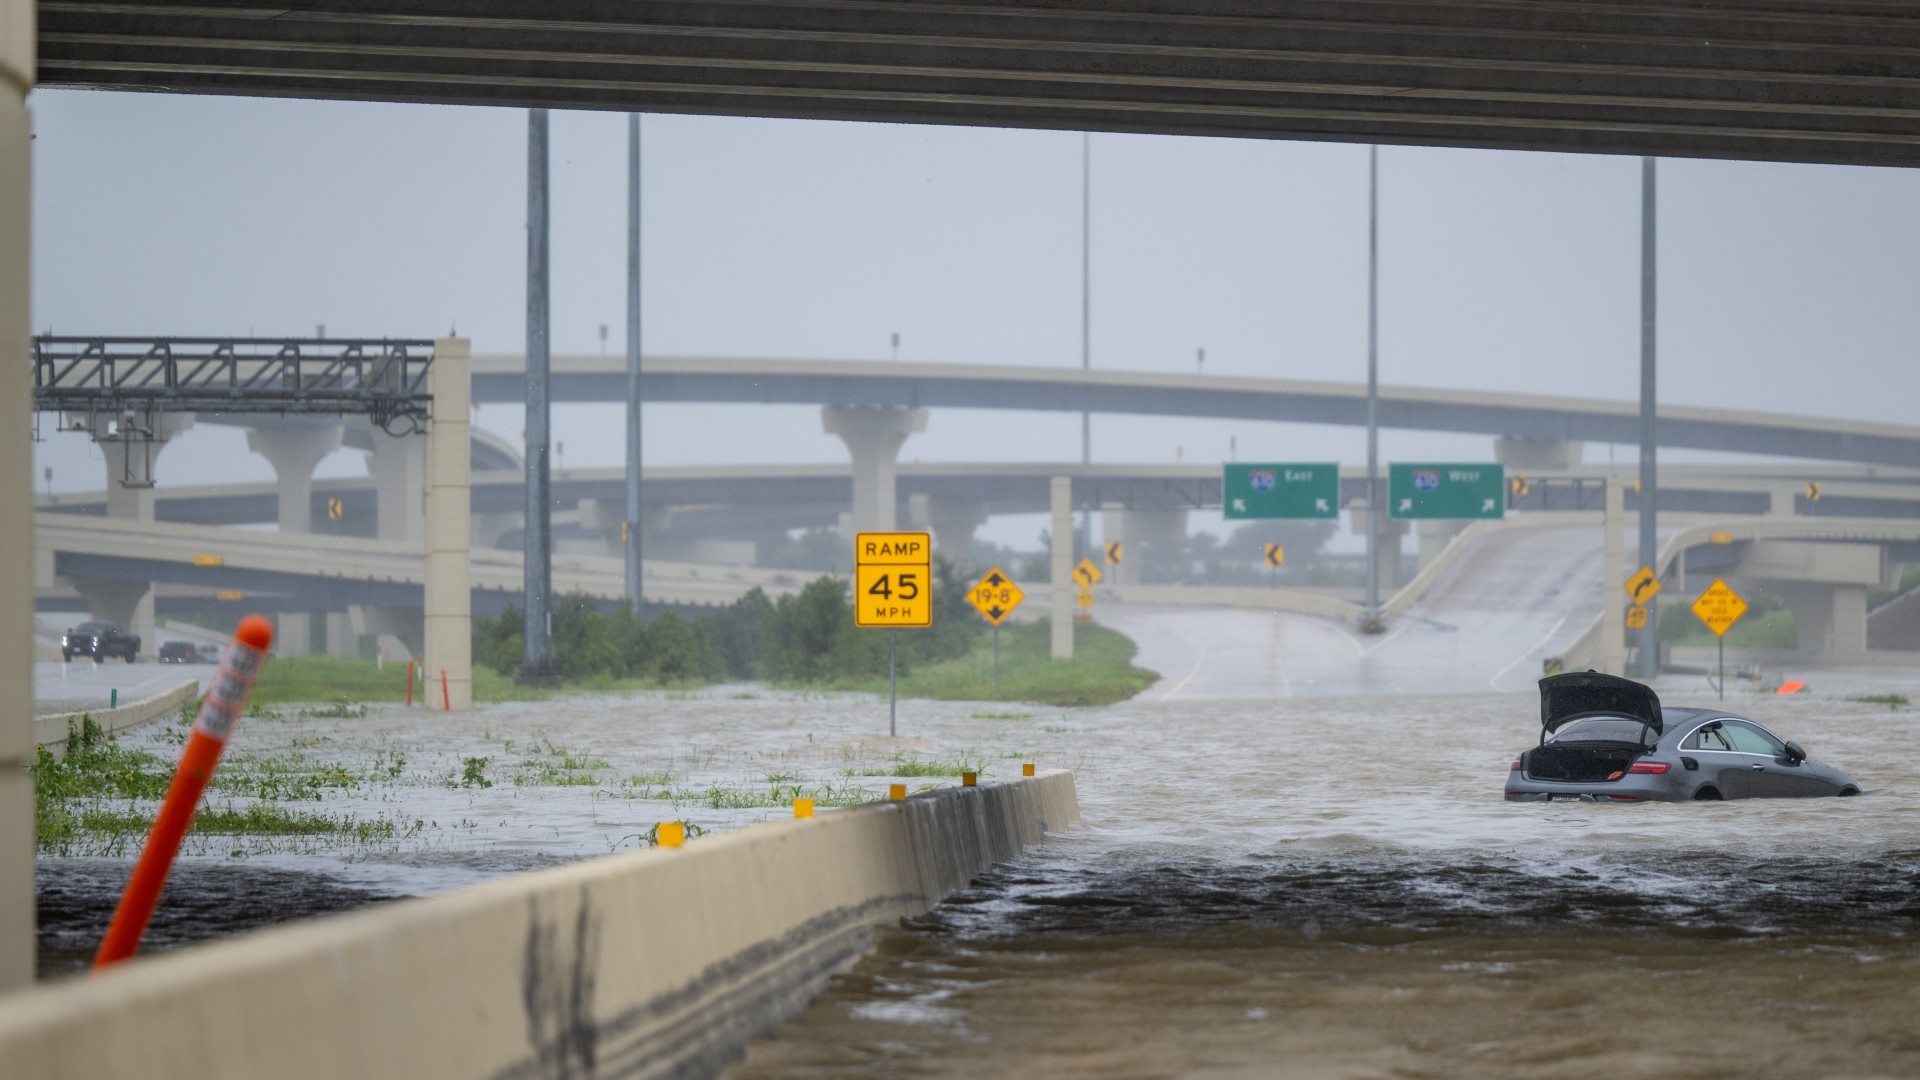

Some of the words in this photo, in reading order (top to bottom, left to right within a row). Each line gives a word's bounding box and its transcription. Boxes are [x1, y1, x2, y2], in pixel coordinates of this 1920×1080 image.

[866, 542, 921, 556] RAMP
[868, 574, 918, 600] 45
[876, 607, 911, 618] MPH
